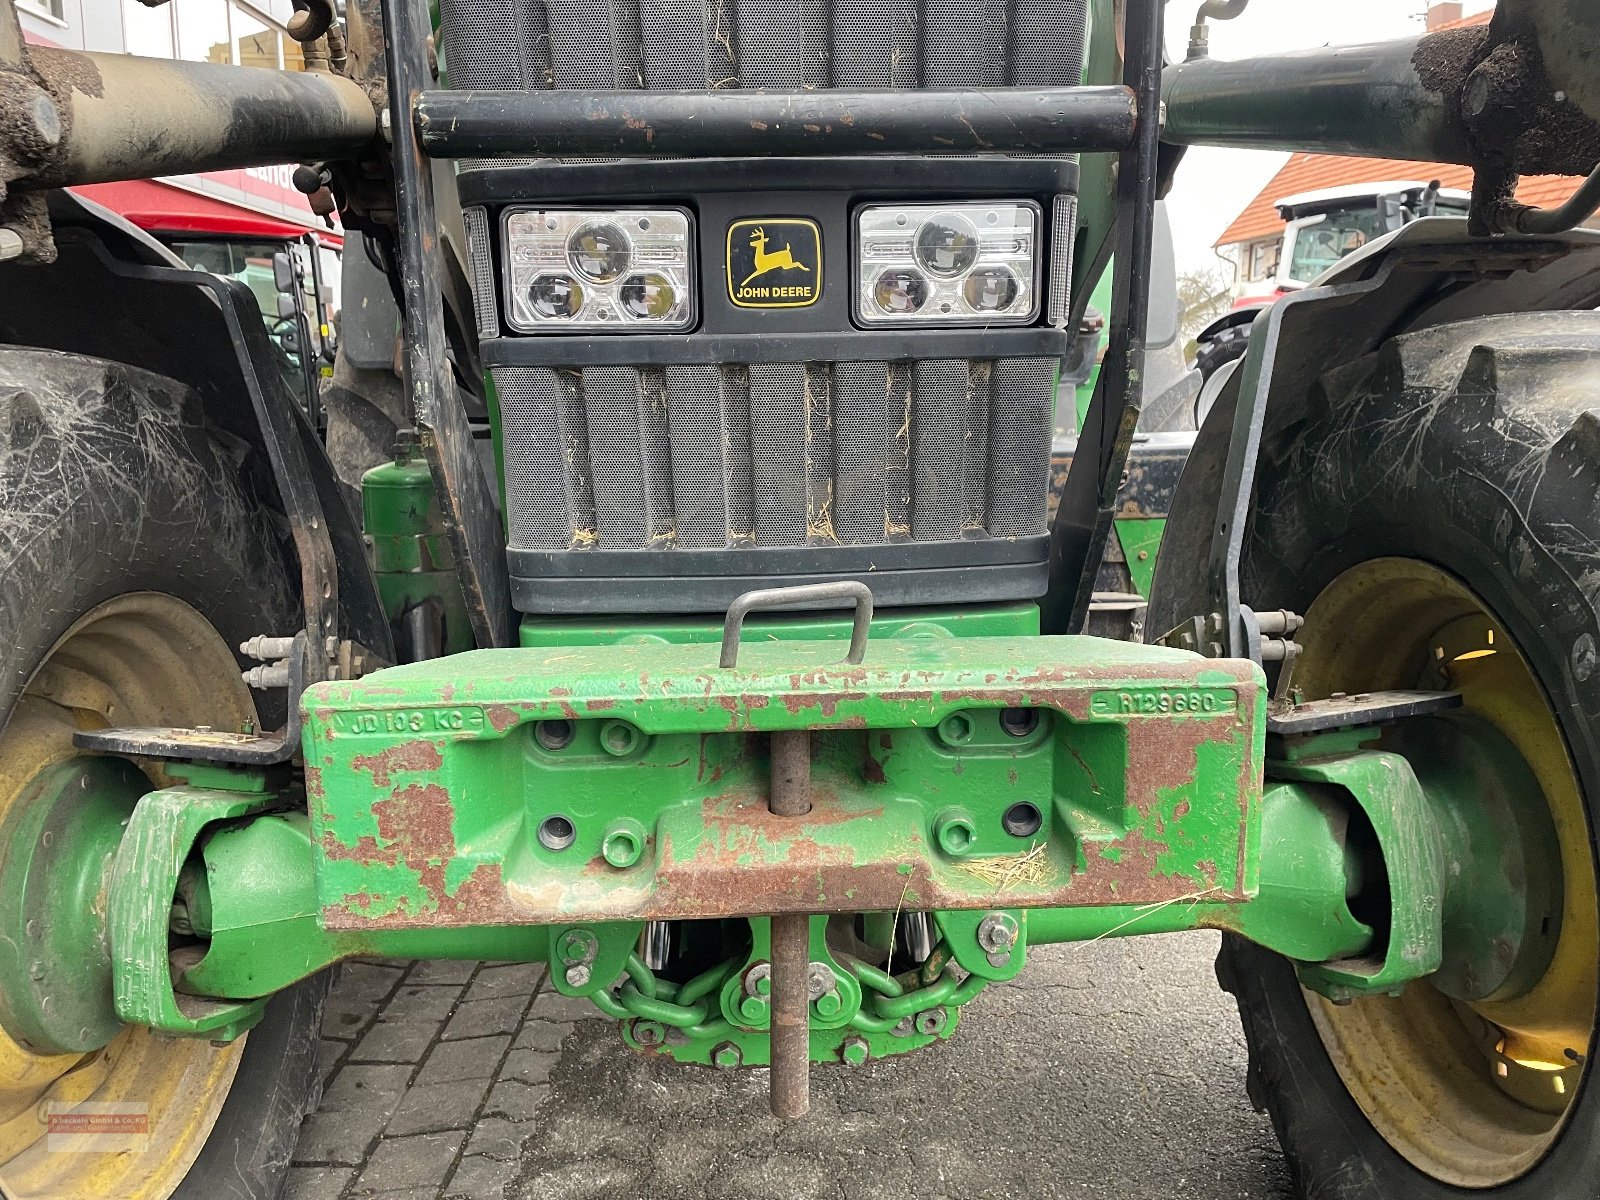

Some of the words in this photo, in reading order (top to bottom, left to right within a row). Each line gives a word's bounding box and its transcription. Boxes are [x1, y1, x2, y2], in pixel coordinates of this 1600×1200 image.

[246, 163, 300, 192] and
[737, 287, 770, 297] JOHN
[772, 287, 811, 297] DEERE
[1118, 693, 1214, 712] R129660
[352, 714, 377, 734] JD
[434, 711, 462, 729] KG
